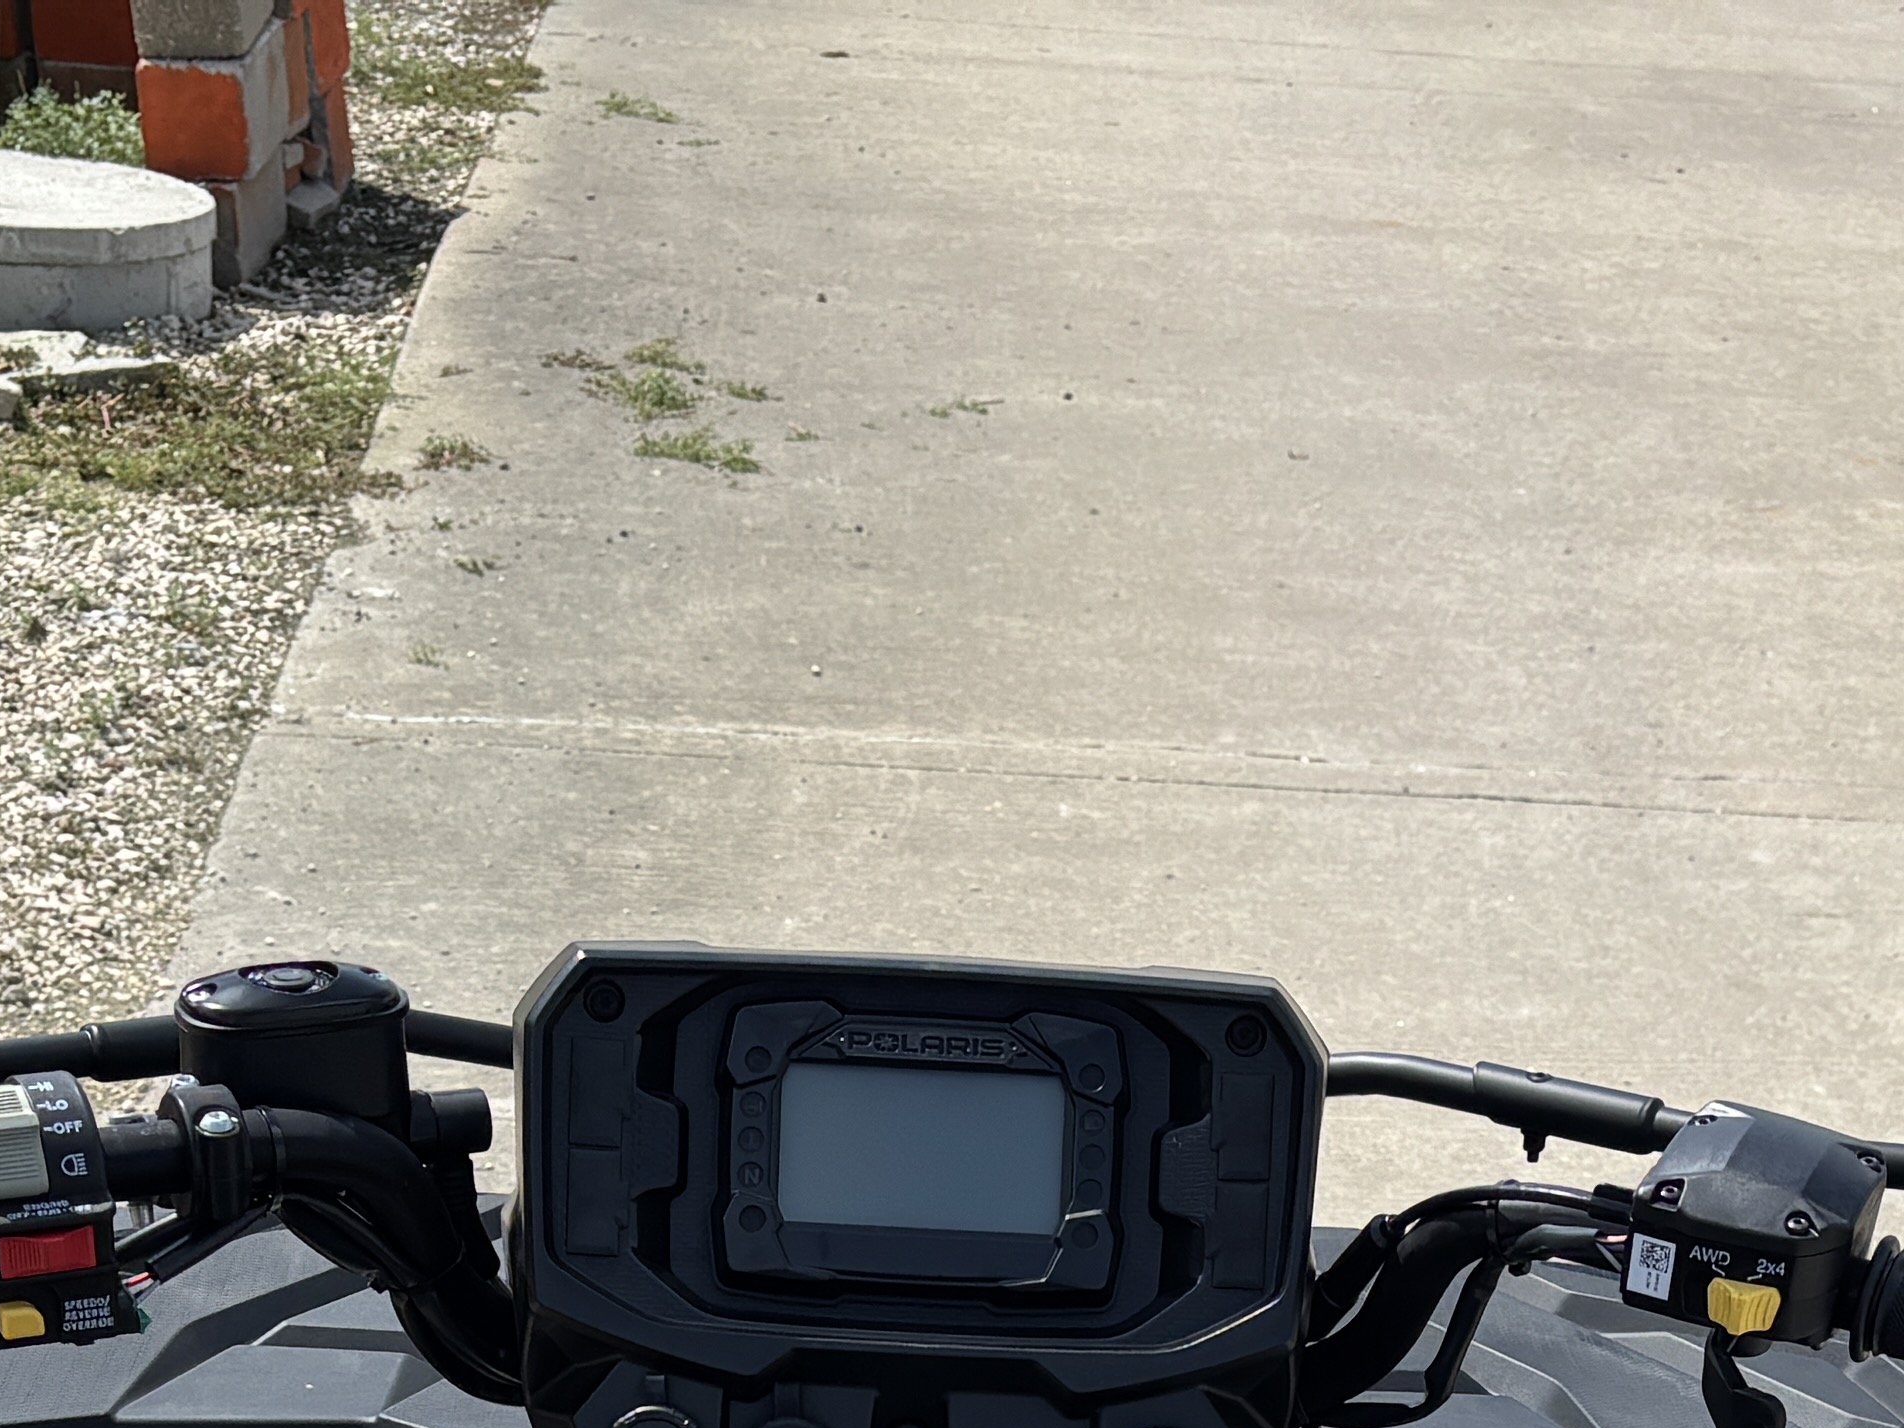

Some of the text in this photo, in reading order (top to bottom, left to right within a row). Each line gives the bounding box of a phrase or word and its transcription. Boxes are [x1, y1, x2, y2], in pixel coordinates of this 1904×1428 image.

[847, 1031, 1004, 1058] POLARIS
[53, 1120, 83, 1134] OFF
[1689, 1245, 1731, 1266] AWD
[1756, 1258, 1785, 1276] 2x4
